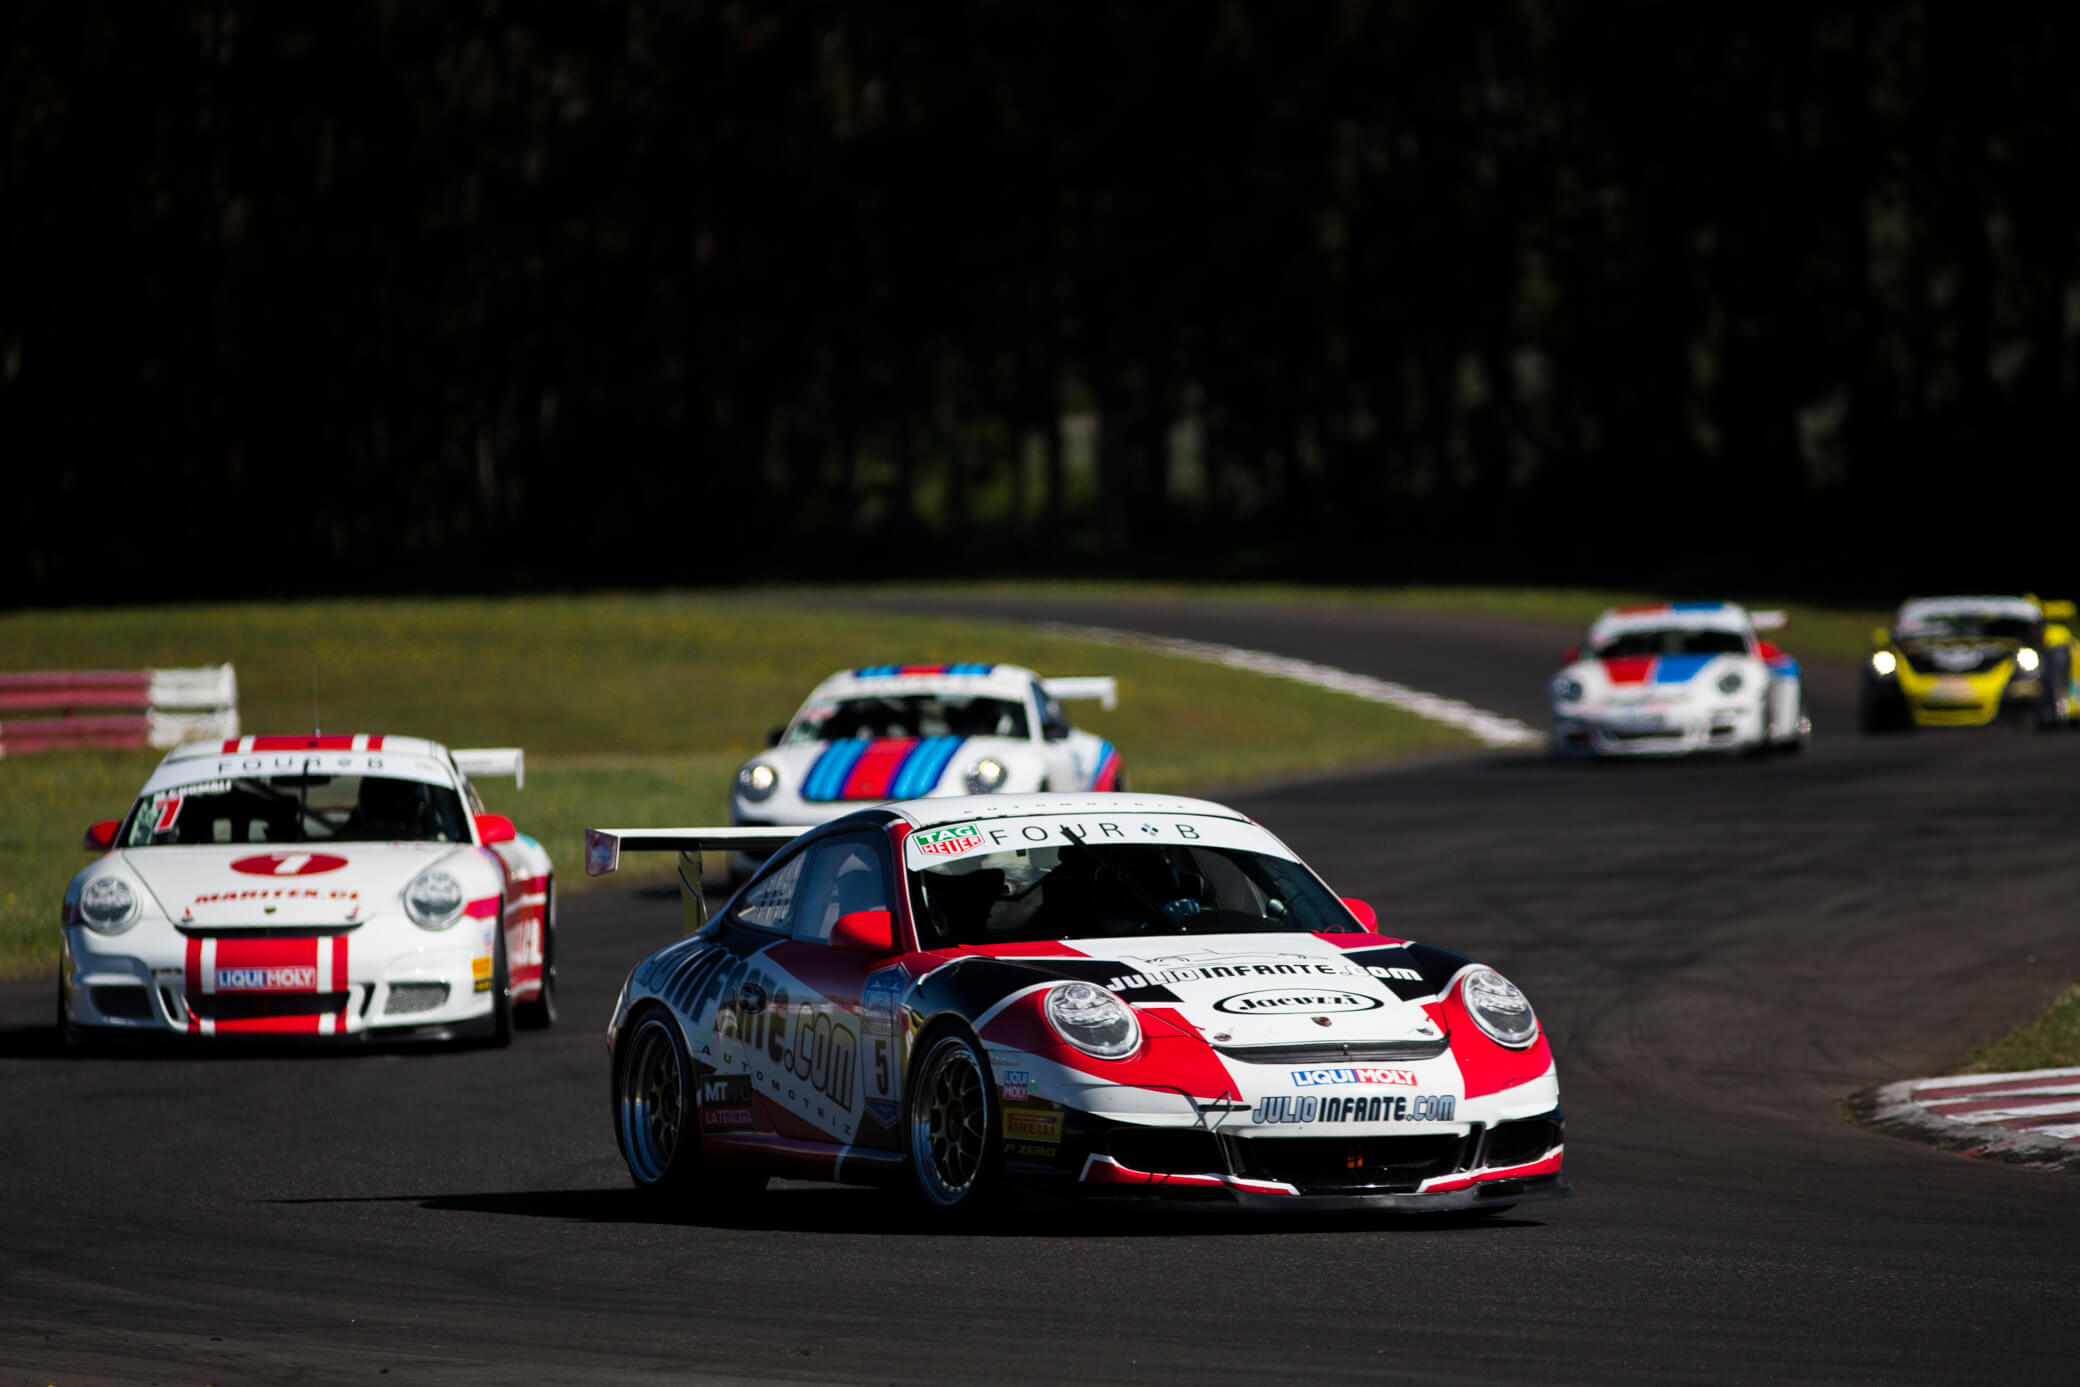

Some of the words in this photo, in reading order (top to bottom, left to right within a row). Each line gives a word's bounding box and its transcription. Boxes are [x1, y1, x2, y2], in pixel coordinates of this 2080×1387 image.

[219, 757, 321, 773] FOUR
[367, 758, 383, 769] B
[154, 797, 184, 833] 7
[915, 825, 978, 847] TAG
[989, 822, 1125, 845] FOUR
[1175, 823, 1201, 840] B
[920, 836, 982, 855] HEUER
[270, 852, 313, 875] 7
[219, 970, 266, 987] LIQUI
[267, 968, 313, 986] MOLY
[1239, 994, 1359, 1010] Jacuzzi
[874, 1039, 889, 1096] 5
[1294, 1070, 1356, 1085] LIQUI
[1358, 1069, 1415, 1084] MOLY
[1004, 1072, 1028, 1085] LIQUI
[700, 1046, 852, 1136] AUTOMOTRIZ
[1003, 1086, 1028, 1099] MOLY
[1007, 1113, 1057, 1136] PIRELLI
[1003, 1143, 1016, 1153] P
[1016, 1144, 1057, 1158] ZERO
